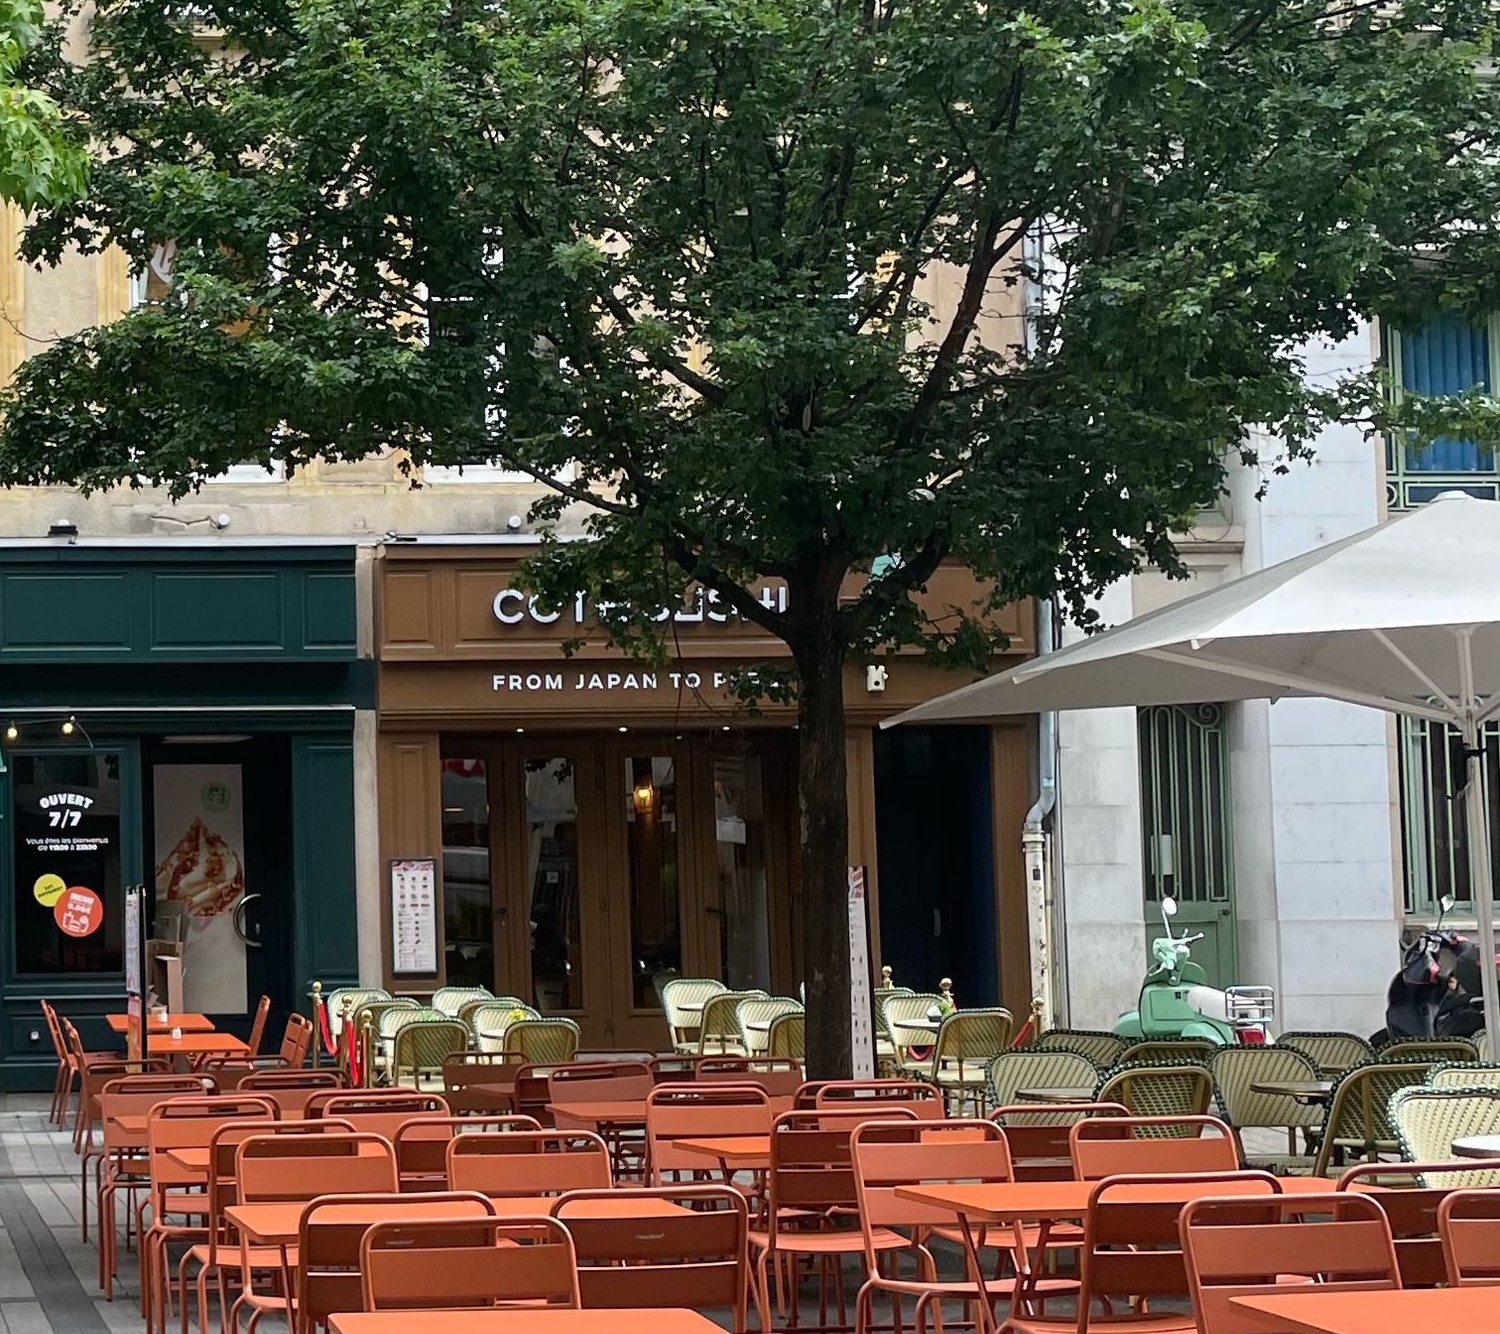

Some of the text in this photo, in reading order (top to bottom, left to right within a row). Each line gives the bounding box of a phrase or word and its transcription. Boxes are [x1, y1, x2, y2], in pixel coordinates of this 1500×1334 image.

[493, 674, 563, 691] FROM
[575, 673, 658, 690] JAPAN
[669, 672, 701, 688] TO
[39, 793, 93, 809] OUVERT
[49, 809, 82, 829] 7/7
